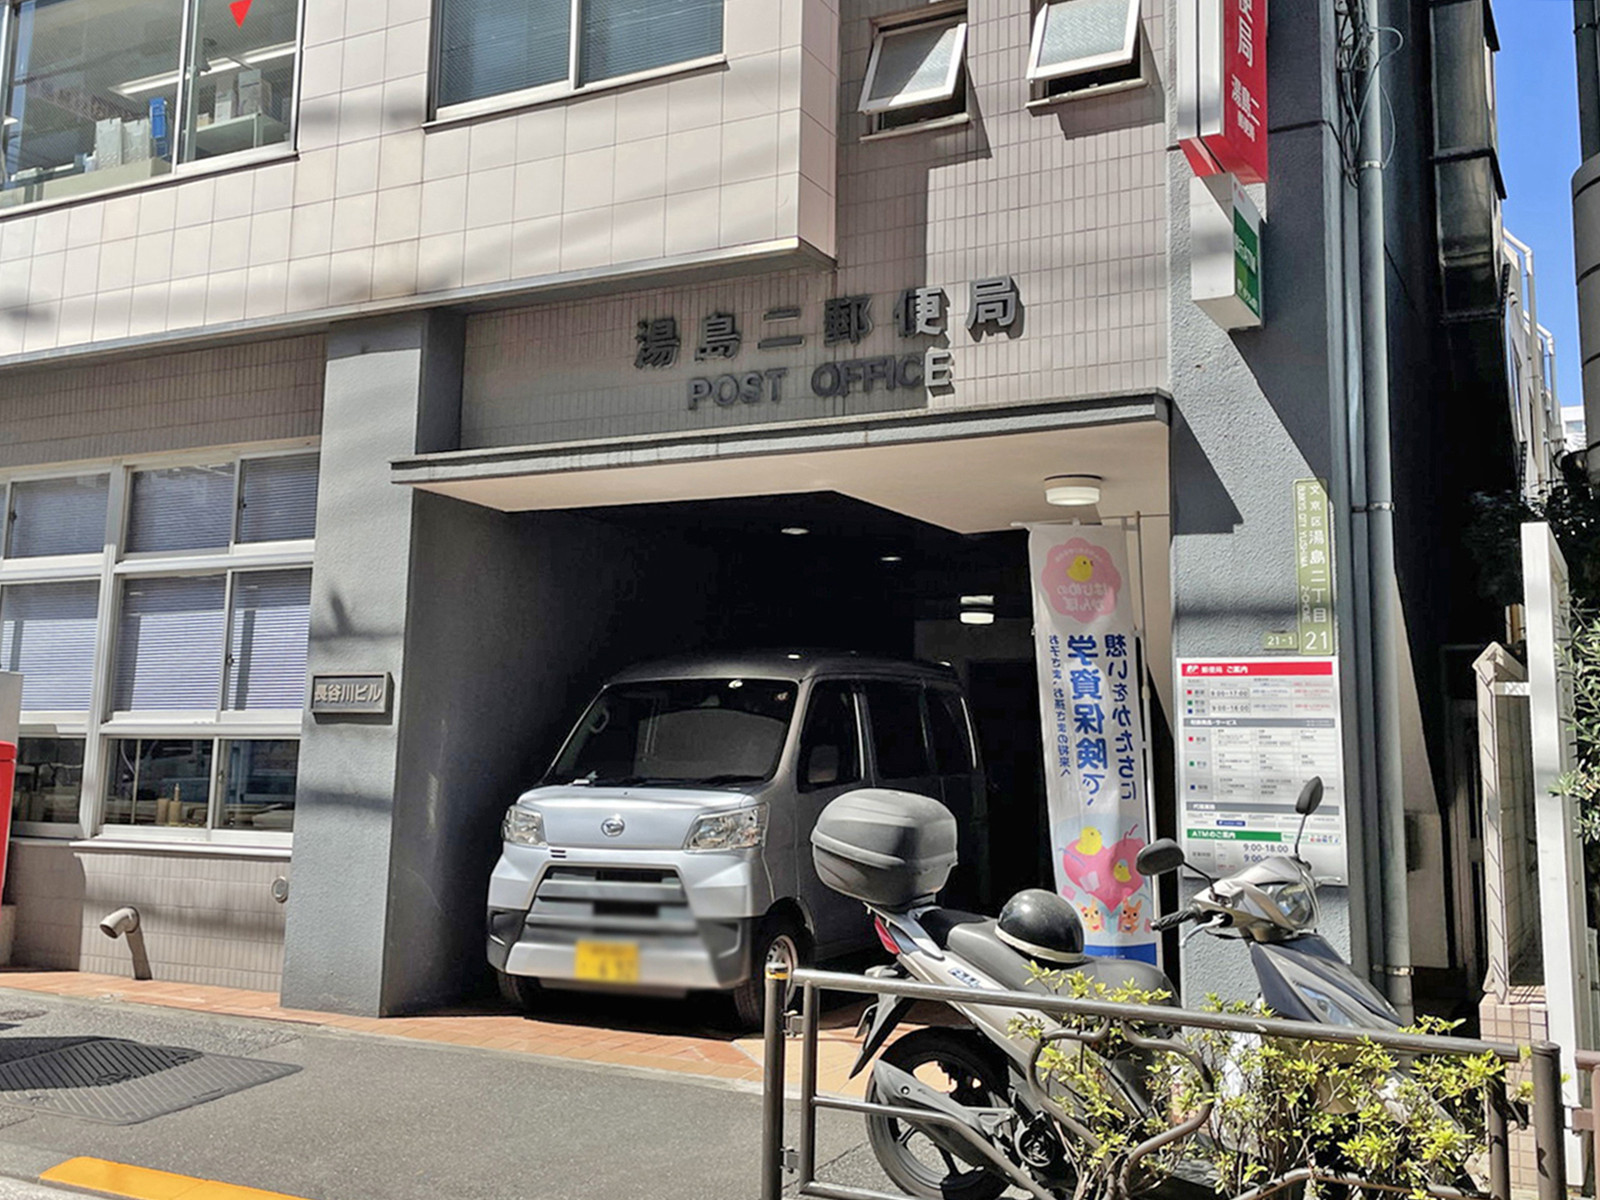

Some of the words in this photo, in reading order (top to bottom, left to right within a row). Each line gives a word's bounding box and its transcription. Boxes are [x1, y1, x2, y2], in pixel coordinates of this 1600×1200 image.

[634, 275, 1019, 370] 湯島二郵便局
[687, 366, 788, 410] POST
[810, 347, 953, 398] OFFICE
[1267, 635, 1294, 646] 21-1
[1305, 631, 1328, 650] 21
[315, 683, 382, 702] 長谷川ビル
